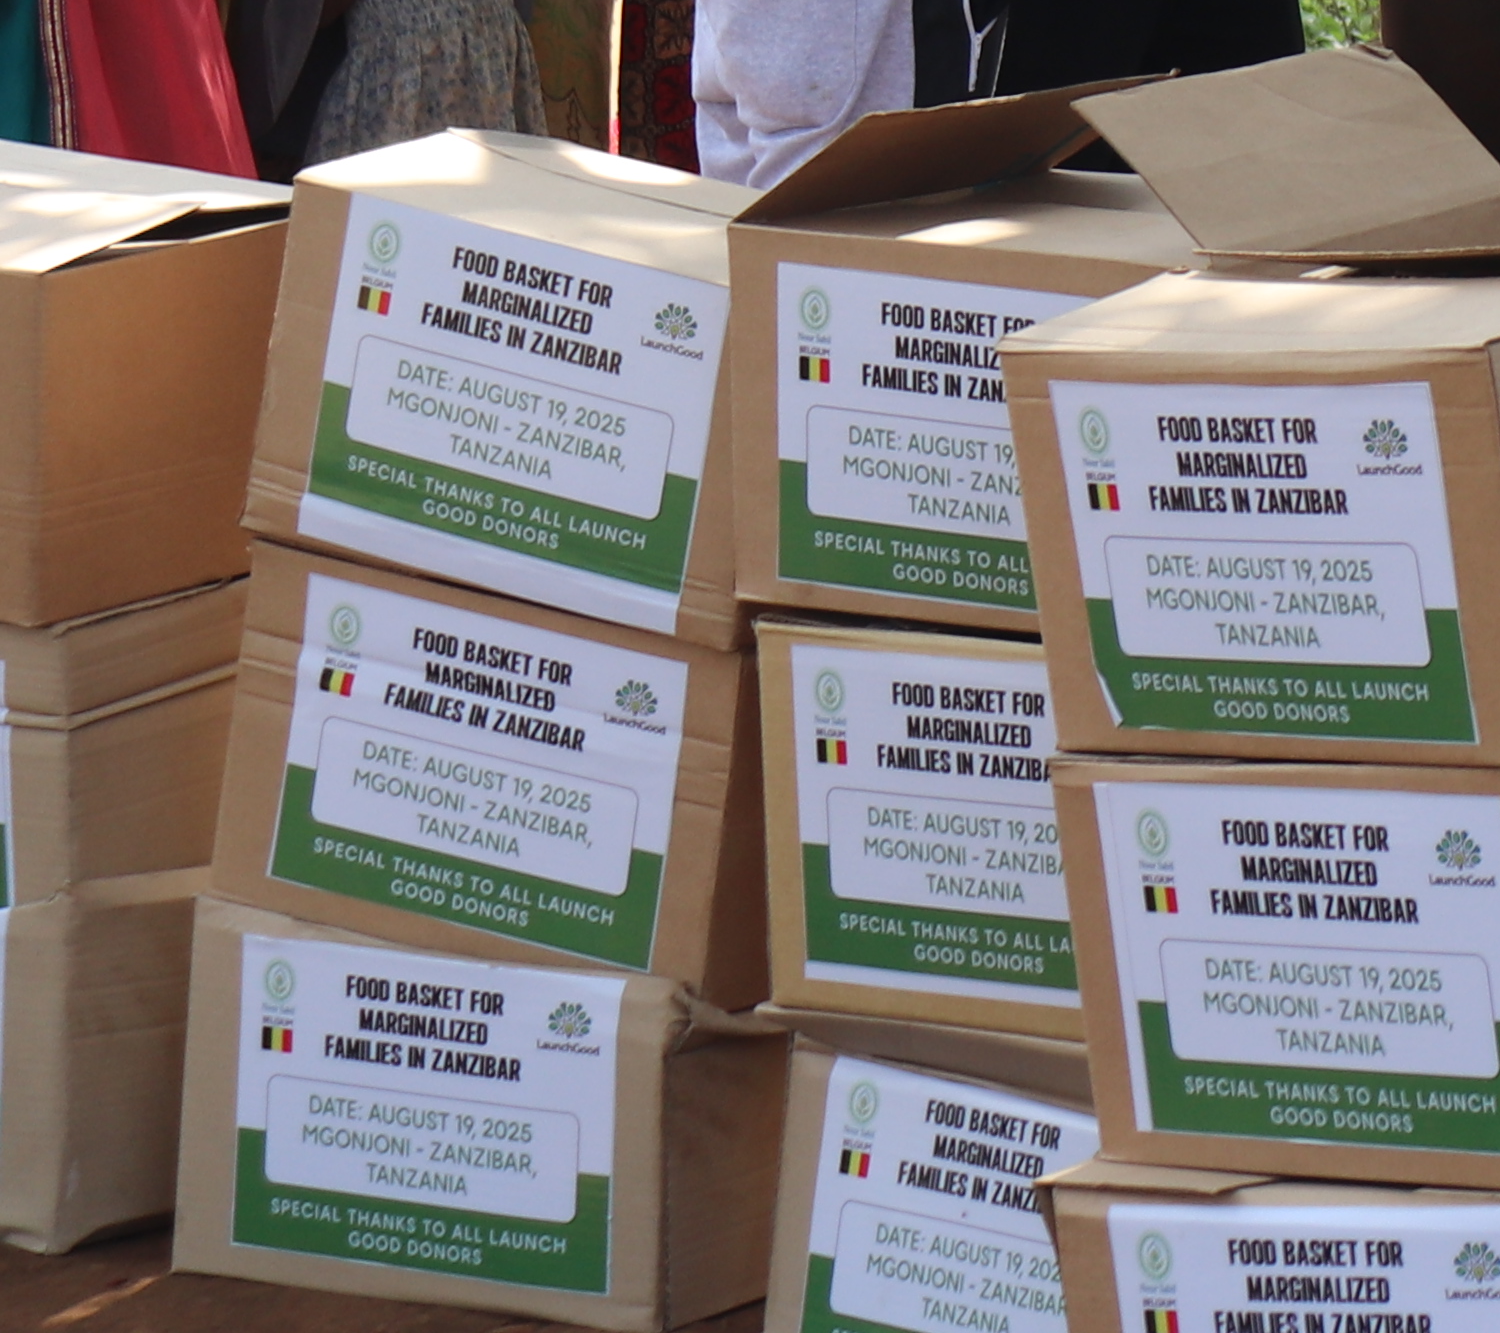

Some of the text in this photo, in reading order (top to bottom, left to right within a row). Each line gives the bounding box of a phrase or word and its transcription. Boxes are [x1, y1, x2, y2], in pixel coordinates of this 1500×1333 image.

[453, 247, 614, 309] FOOD BASKET FOR
[461, 280, 593, 335] MARGINALIZED
[422, 302, 623, 375] FAMILIES IN ZANZIBAR
[398, 359, 626, 437] DATE: AUGUST 19, 2025
[387, 387, 499, 434] MGONJONI
[516, 422, 625, 472] ZANZIBAR,
[1157, 416, 1318, 445] FOOD BASKET FOR
[450, 433, 552, 480] TANZANIA
[1176, 452, 1308, 479] MARGINALIZED
[346, 455, 646, 550] SPECIAL THANKS TO ALL LAUNCH
[1149, 486, 1349, 515] FAMILIES IN ZANZIBAR
[422, 499, 559, 550] GOOD DONORS
[1146, 554, 1373, 587] DATE: AUGUST 19, 2025
[1146, 588, 1256, 613] MGONJONI
[1273, 592, 1385, 621] ZANZIBAR,
[1215, 623, 1321, 648] TANZANIA
[1132, 672, 1429, 702] SPECIAL THANKS TO ALL LAUNCH
[1214, 700, 1351, 724] GOOD DONORS
[347, 974, 505, 1017] FOOD BASKET FOR
[359, 1007, 488, 1046] MARGINALIZED
[325, 1034, 521, 1082] FAMILIES IN ZANZIBAR
[1227, 1239, 1404, 1268] FOOD BASKET FOR
[1246, 1275, 1390, 1304] MARGINALIZED
